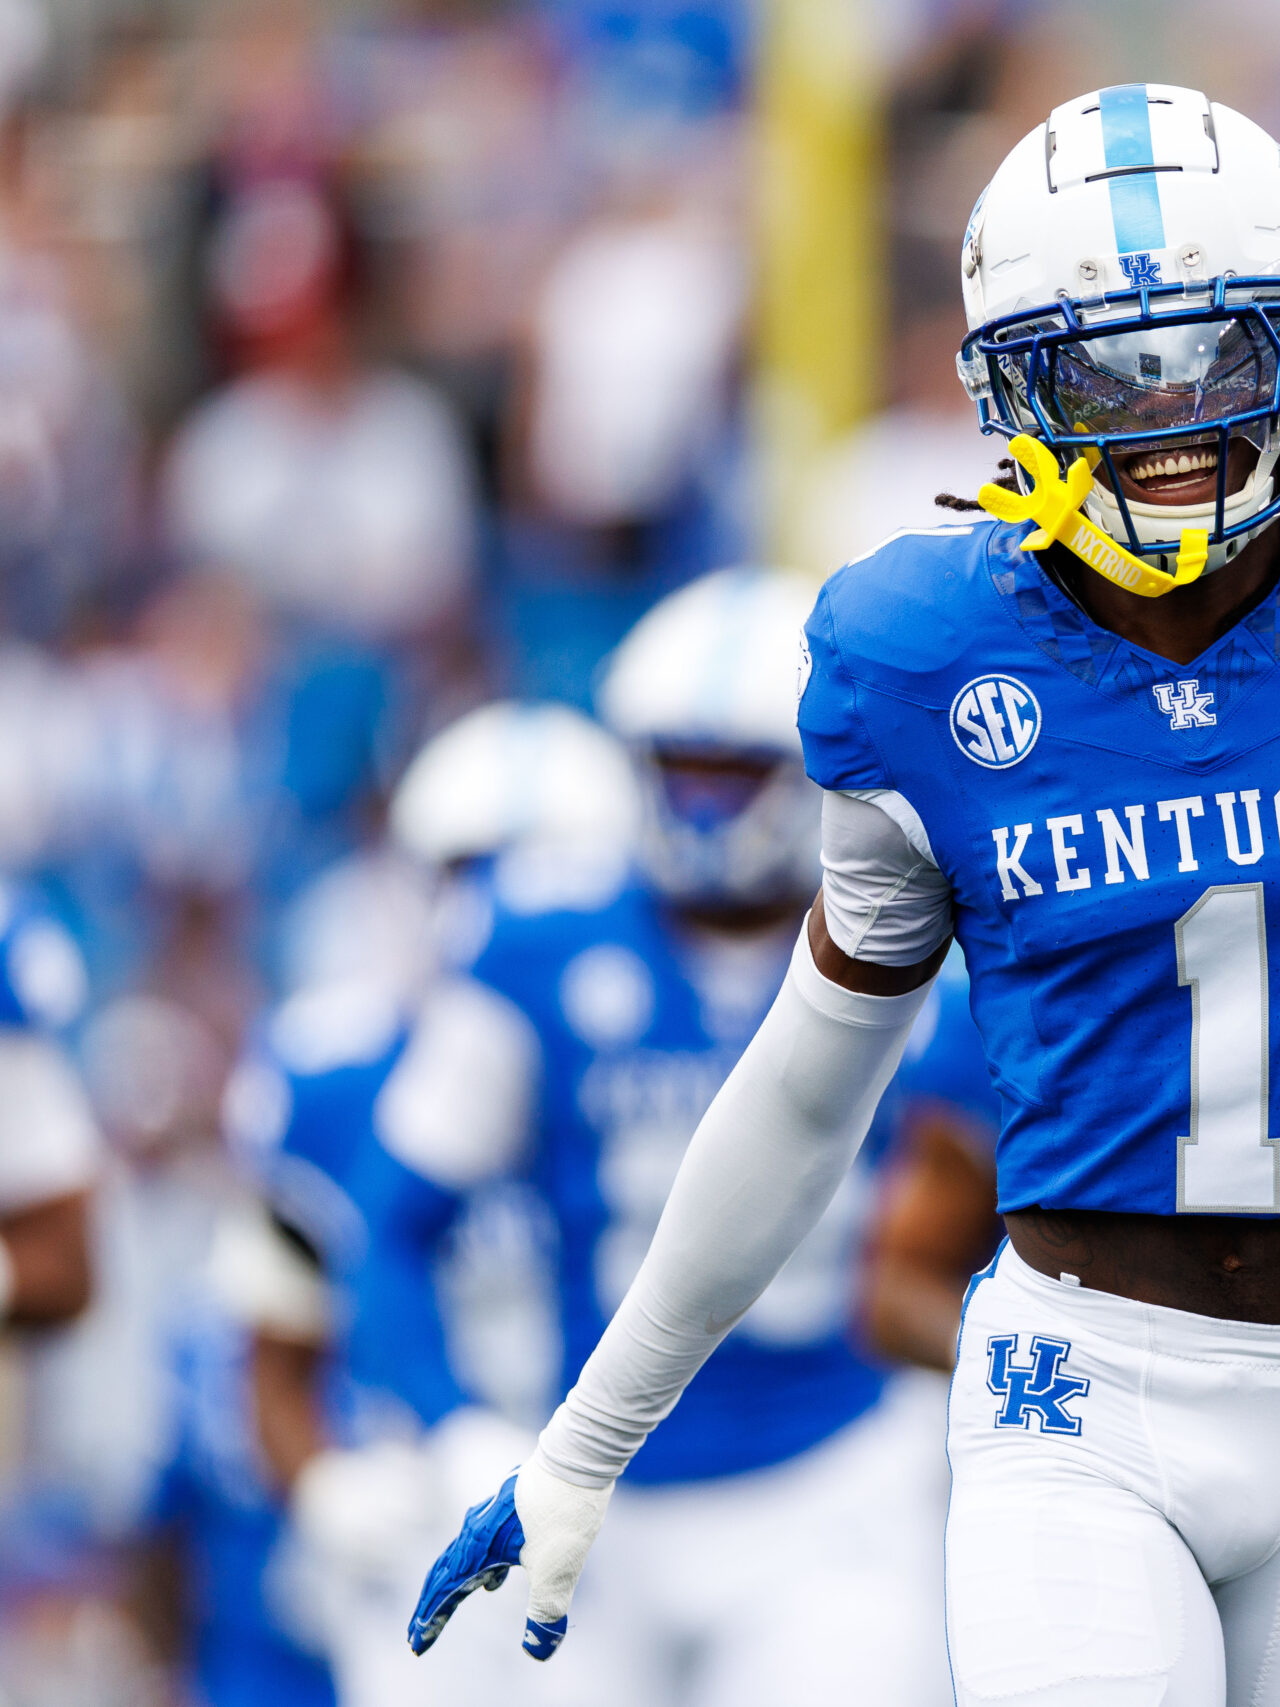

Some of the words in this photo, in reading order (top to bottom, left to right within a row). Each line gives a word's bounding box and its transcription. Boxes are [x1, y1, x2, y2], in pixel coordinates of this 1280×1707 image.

[1118, 253, 1162, 289] UK
[1070, 524, 1142, 587] NXTRND
[956, 681, 1035, 763] SEC
[1152, 679, 1217, 731] UK
[986, 1333, 1091, 1437] UK
